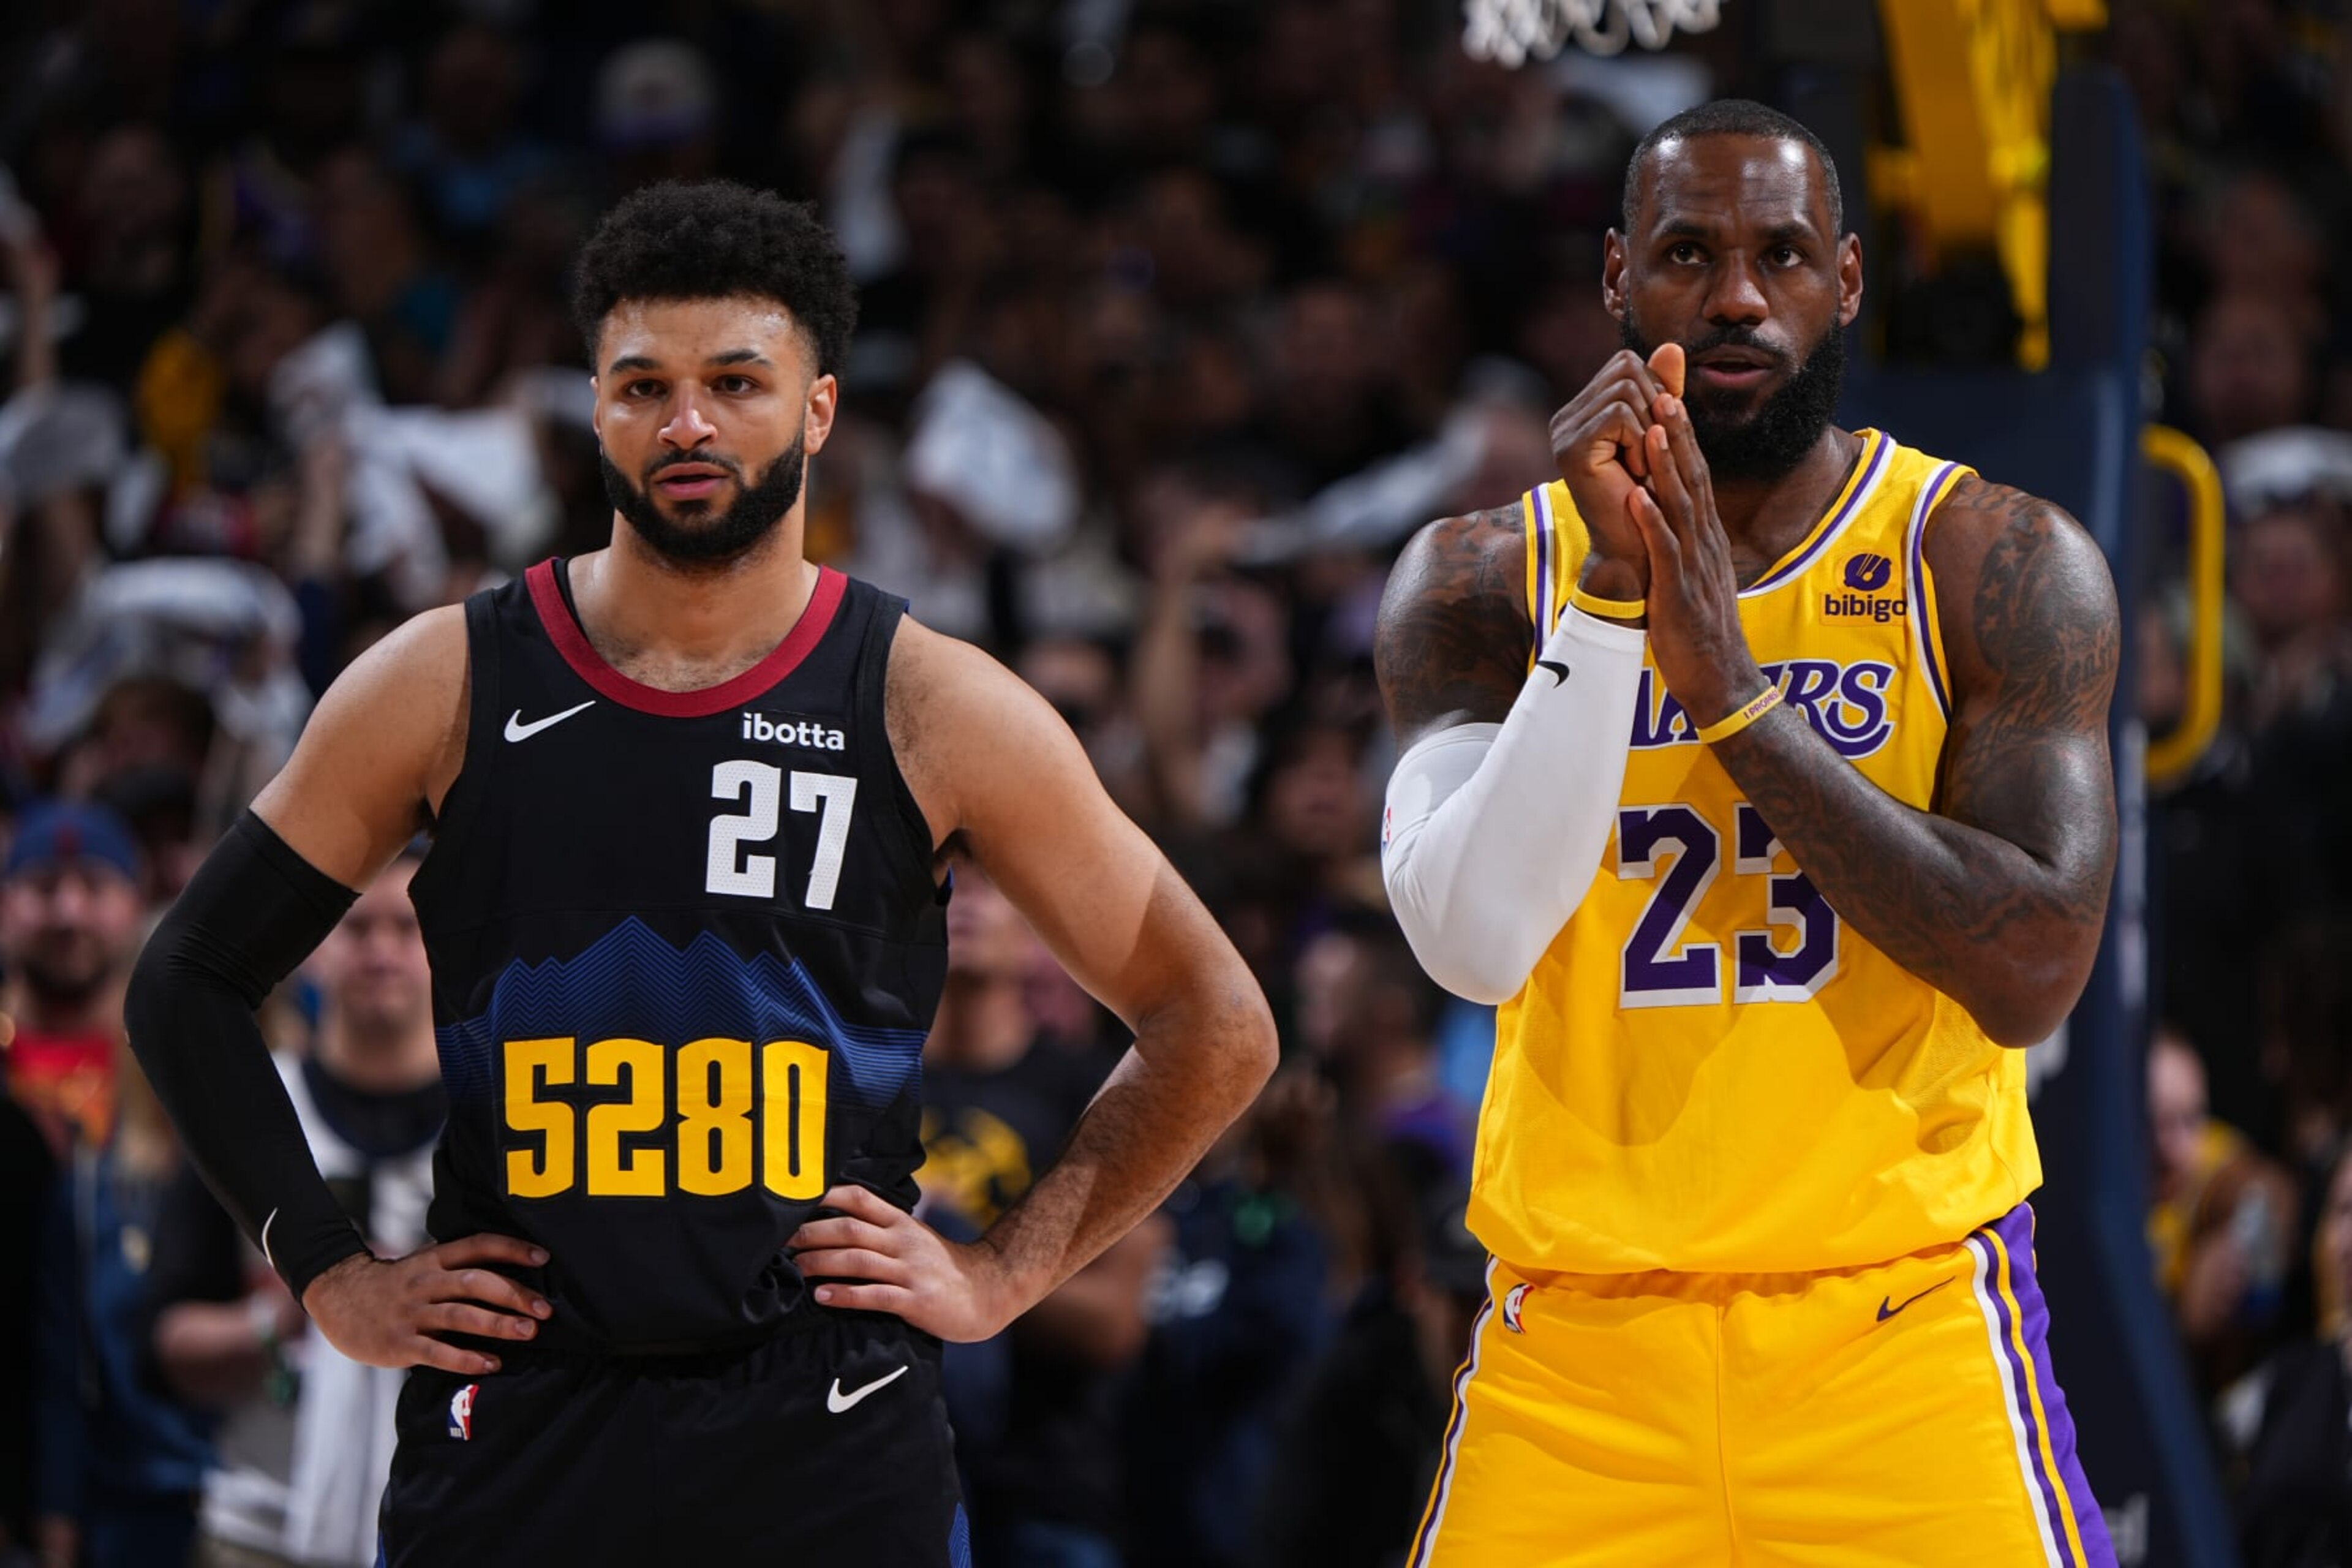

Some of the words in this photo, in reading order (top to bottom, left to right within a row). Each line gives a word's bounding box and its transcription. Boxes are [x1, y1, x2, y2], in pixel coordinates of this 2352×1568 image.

[1825, 594, 1908, 623] bibigo
[742, 712, 845, 751] ibotta
[705, 760, 858, 910] 27
[1615, 802, 1841, 1009] 23
[503, 1036, 830, 1201] 5280
